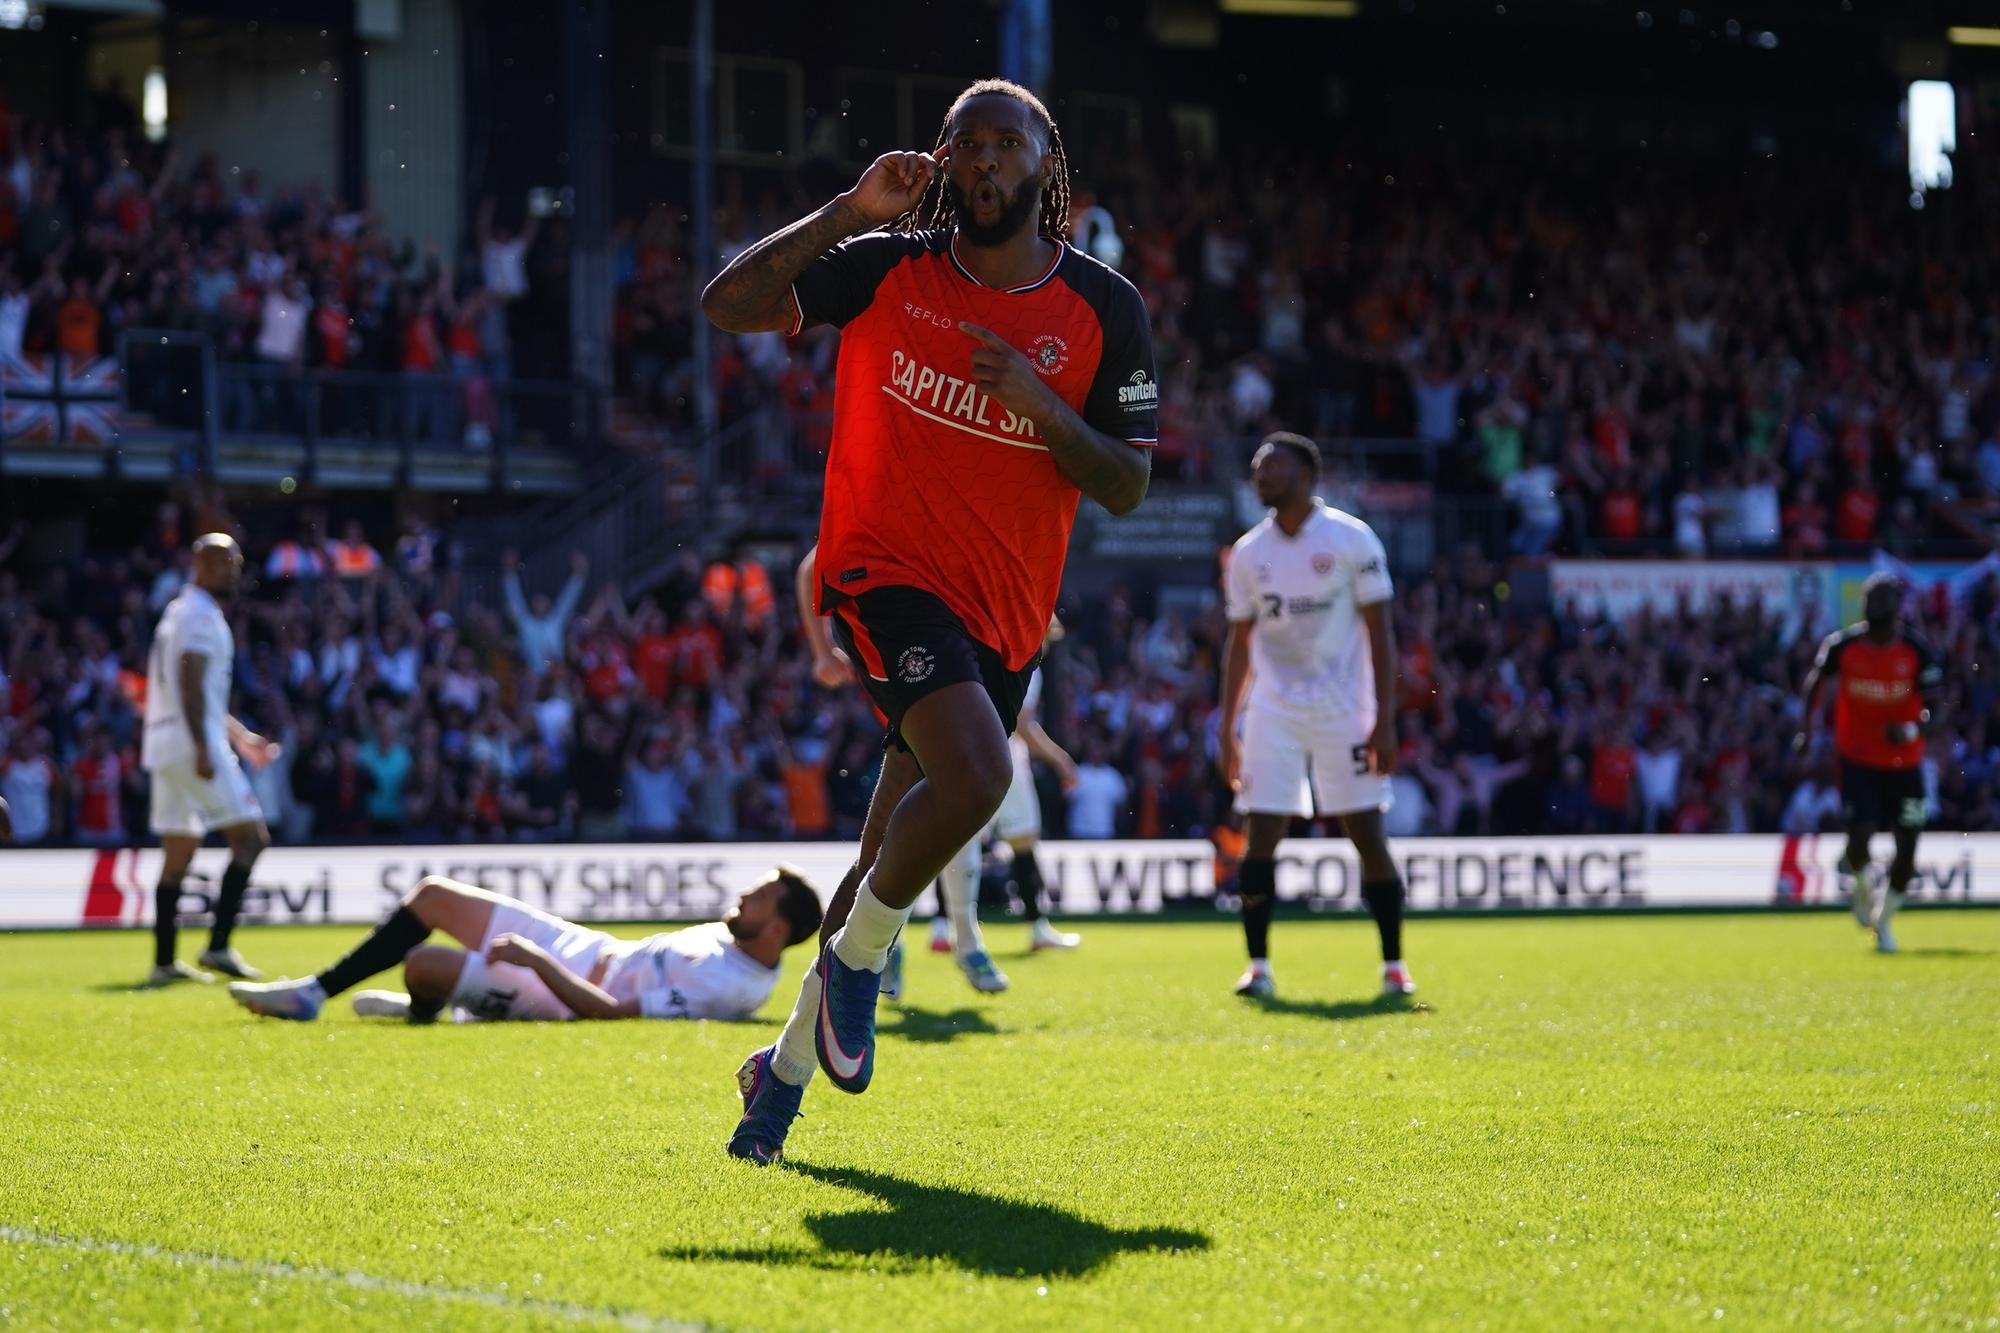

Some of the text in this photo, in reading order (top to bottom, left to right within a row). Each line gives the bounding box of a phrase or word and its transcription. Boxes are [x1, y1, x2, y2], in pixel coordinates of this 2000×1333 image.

[904, 302, 952, 329] REFLO
[1033, 335, 1068, 351] LUTON TOWN
[892, 350, 991, 426] CAPITAL
[1118, 380, 1158, 403] switch
[172, 866, 332, 914] Sevi
[578, 860, 728, 909] SHOES
[1090, 855, 1214, 902] WIT
[1273, 851, 1644, 900] COFIDENCE
